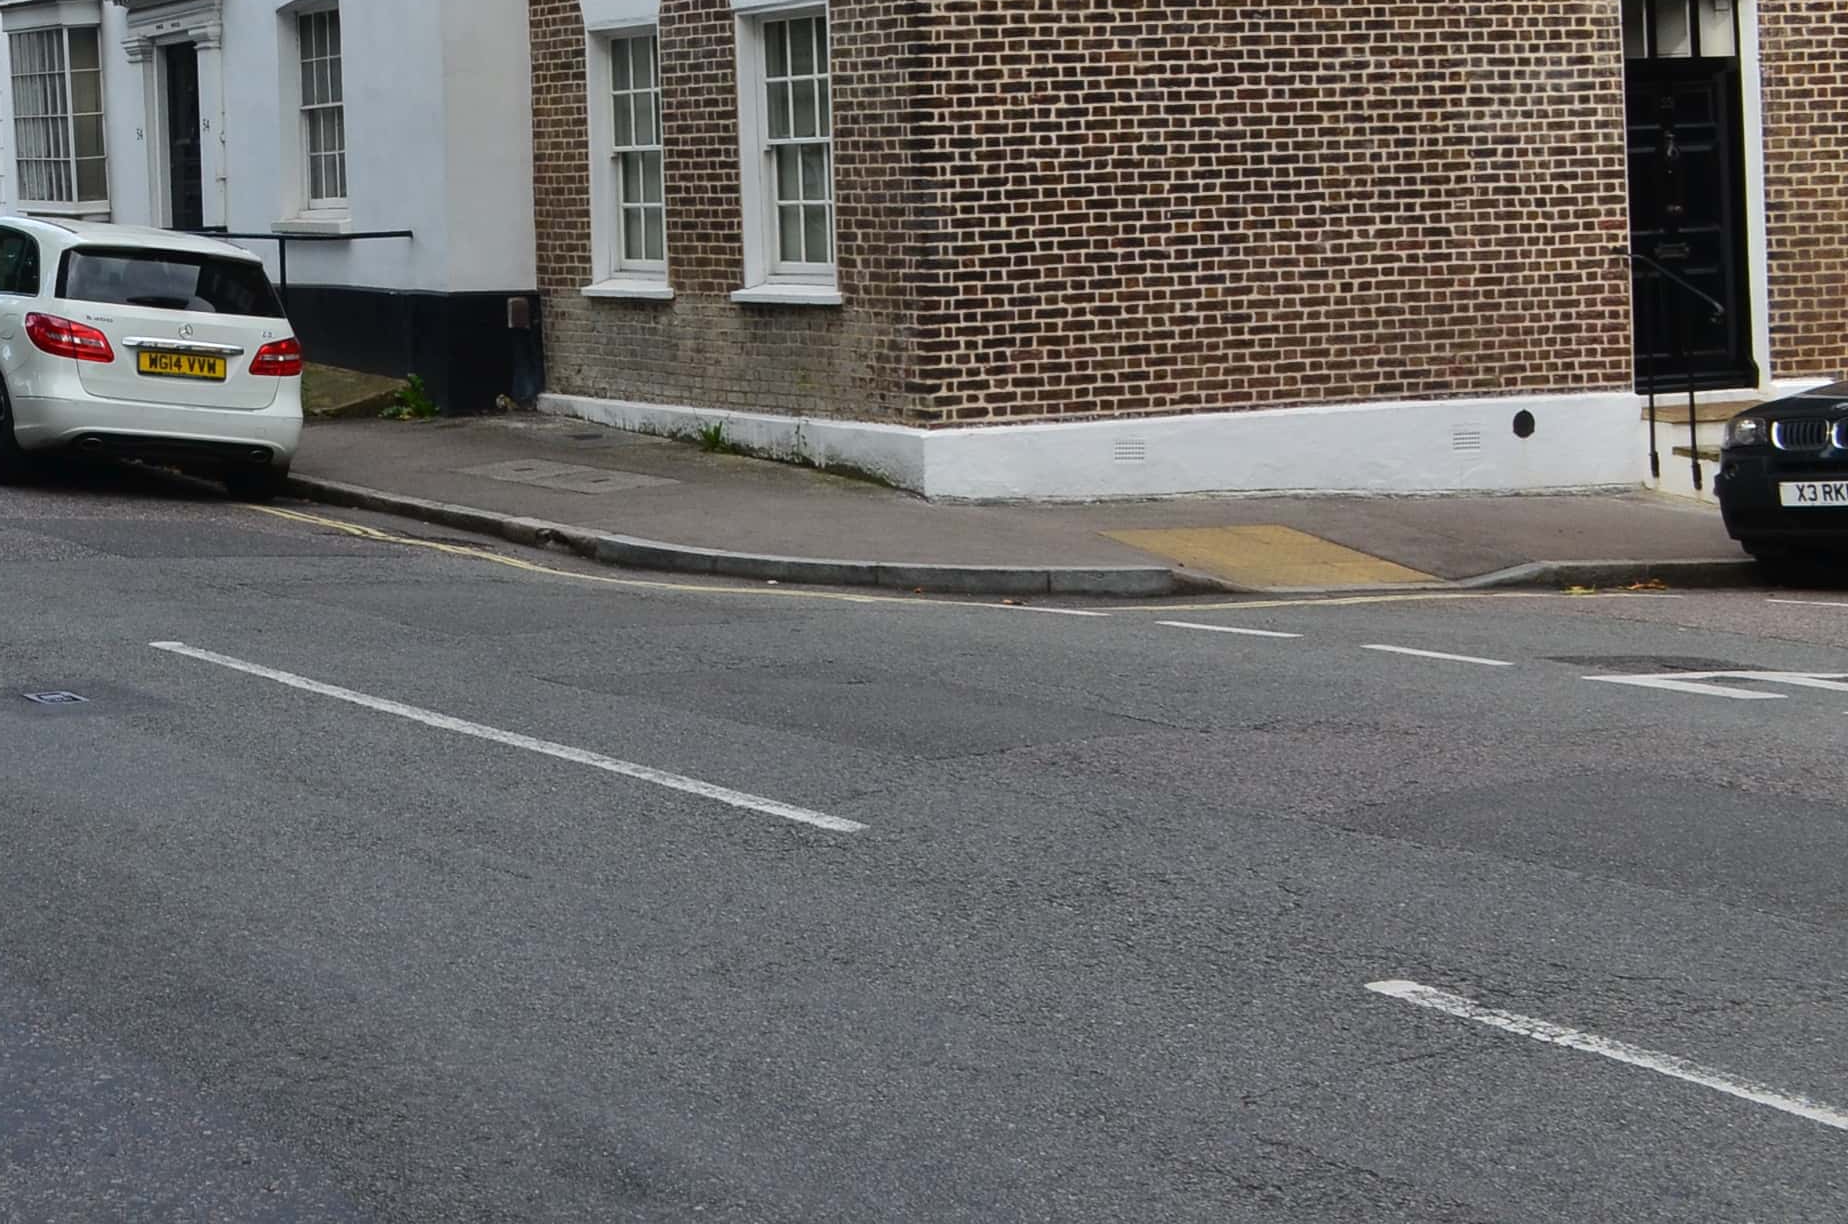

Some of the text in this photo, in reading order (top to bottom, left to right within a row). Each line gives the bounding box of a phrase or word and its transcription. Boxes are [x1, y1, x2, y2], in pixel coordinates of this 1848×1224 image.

[148, 352, 217, 375] WG14 VVW
[1796, 484, 1848, 502] X3 RK
